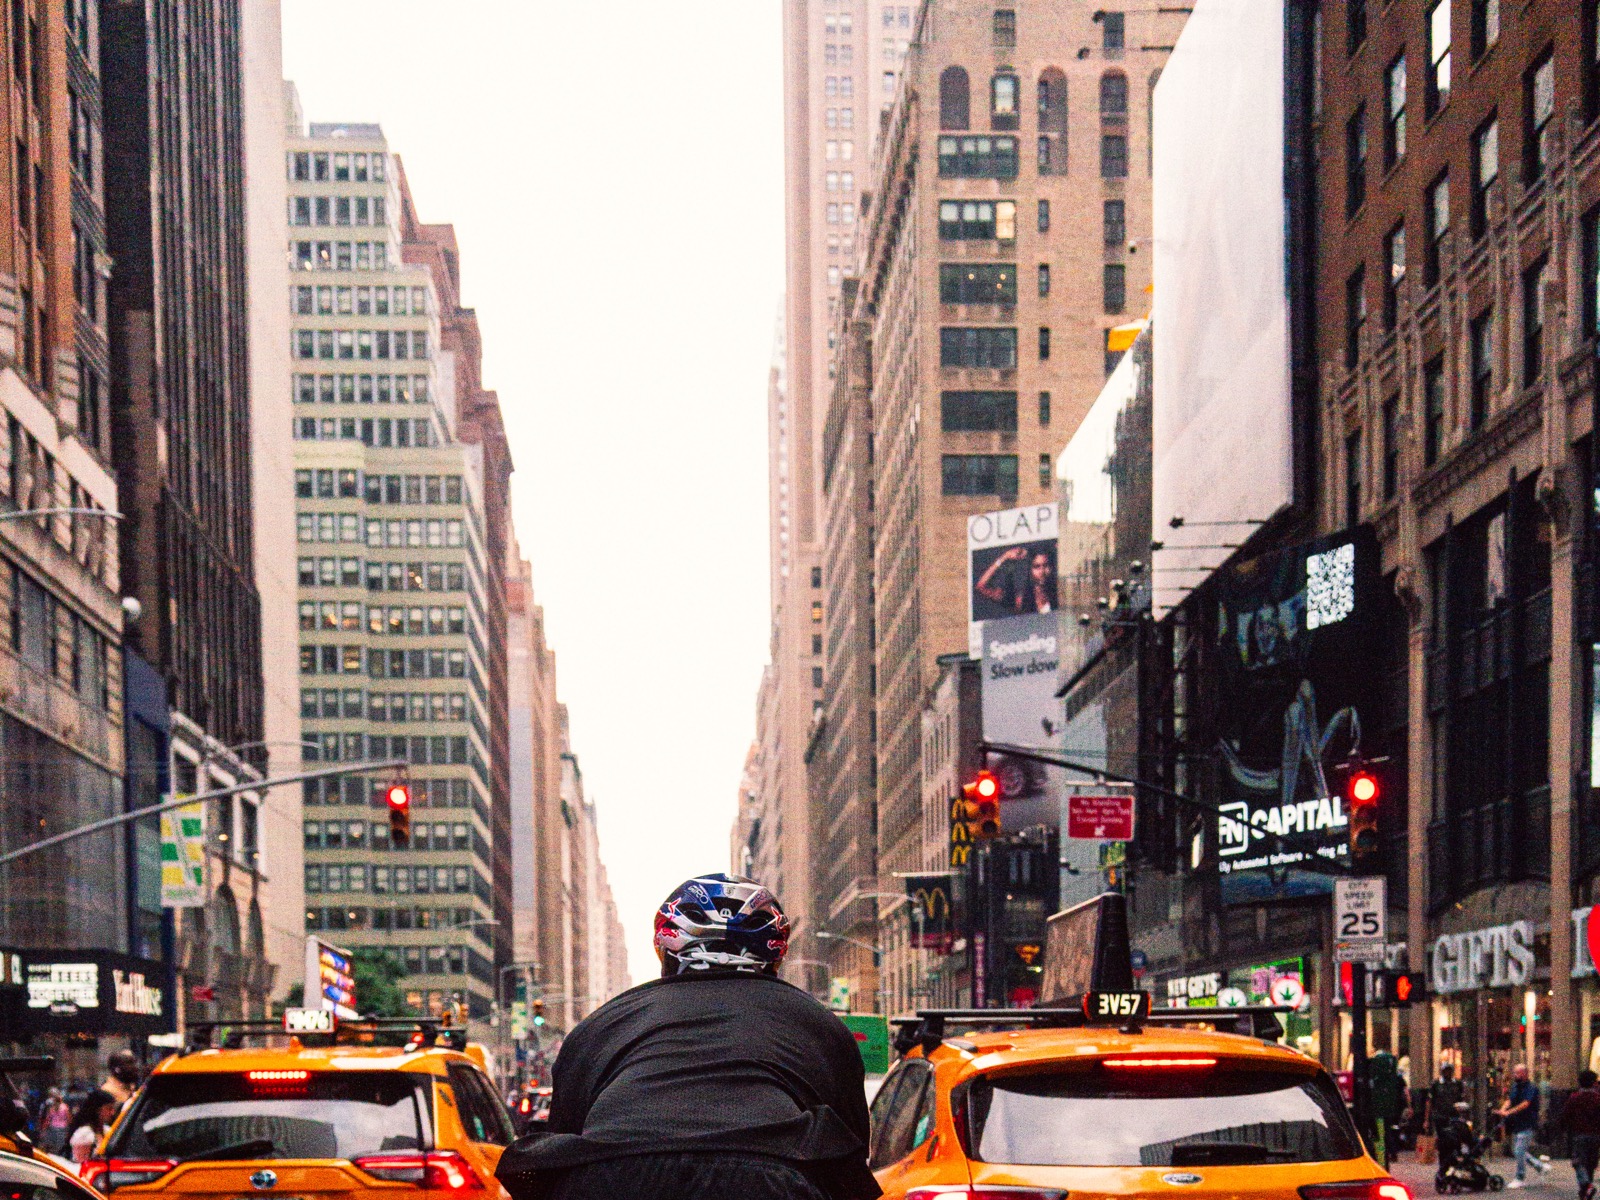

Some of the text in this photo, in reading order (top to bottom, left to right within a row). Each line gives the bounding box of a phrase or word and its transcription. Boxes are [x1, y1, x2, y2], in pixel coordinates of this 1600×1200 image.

[970, 506, 1051, 542] OLAP
[989, 633, 1056, 660] Speeding
[991, 663, 1024, 680] Slow
[1251, 796, 1348, 840] CAPITAL
[1341, 912, 1380, 936] 25
[1432, 920, 1536, 994] GIFTS
[1098, 994, 1141, 1015] 3V57
